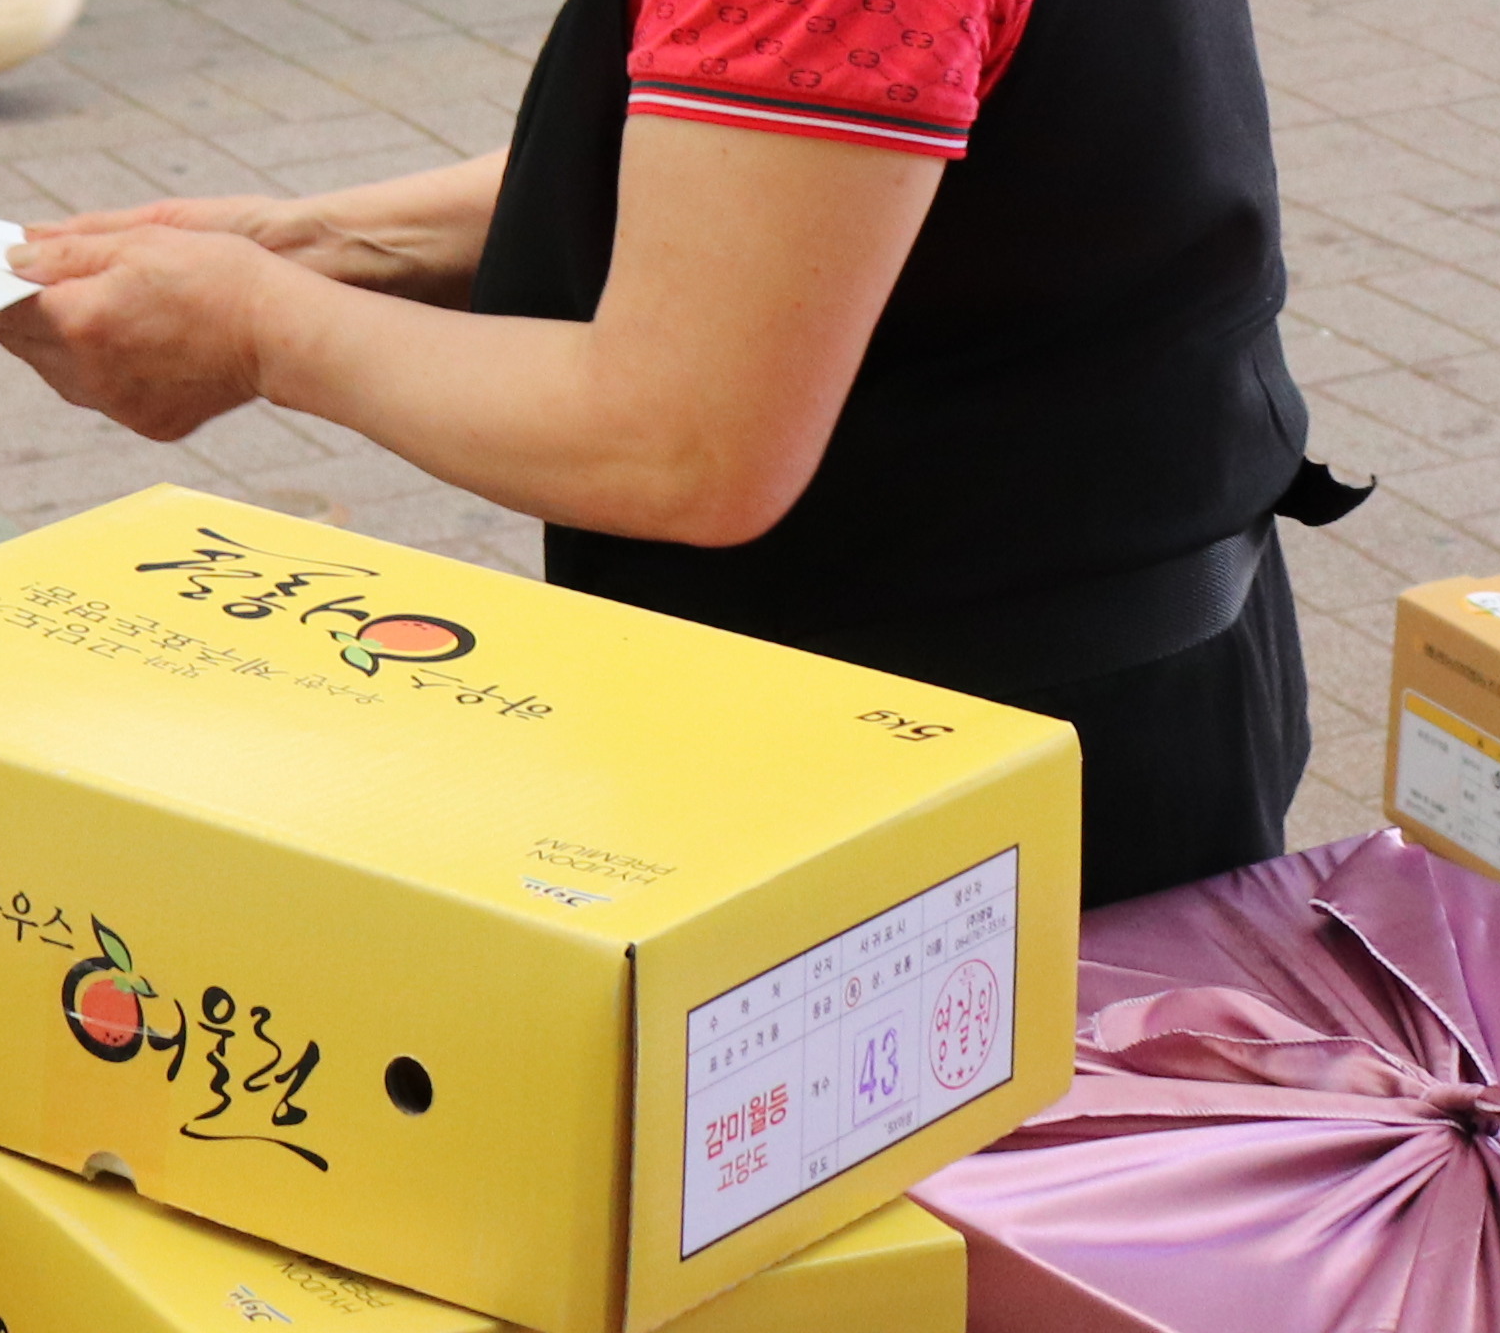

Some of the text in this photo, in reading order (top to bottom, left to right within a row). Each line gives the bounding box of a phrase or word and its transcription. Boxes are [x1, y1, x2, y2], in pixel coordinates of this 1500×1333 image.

[853, 708, 956, 743] 5kg
[525, 847, 658, 886] HYUDON
[533, 835, 678, 877] PREMIUM
[858, 1026, 899, 1105] 43
[704, 1082, 791, 1160] 감미월등
[716, 1141, 769, 1193] 고당도
